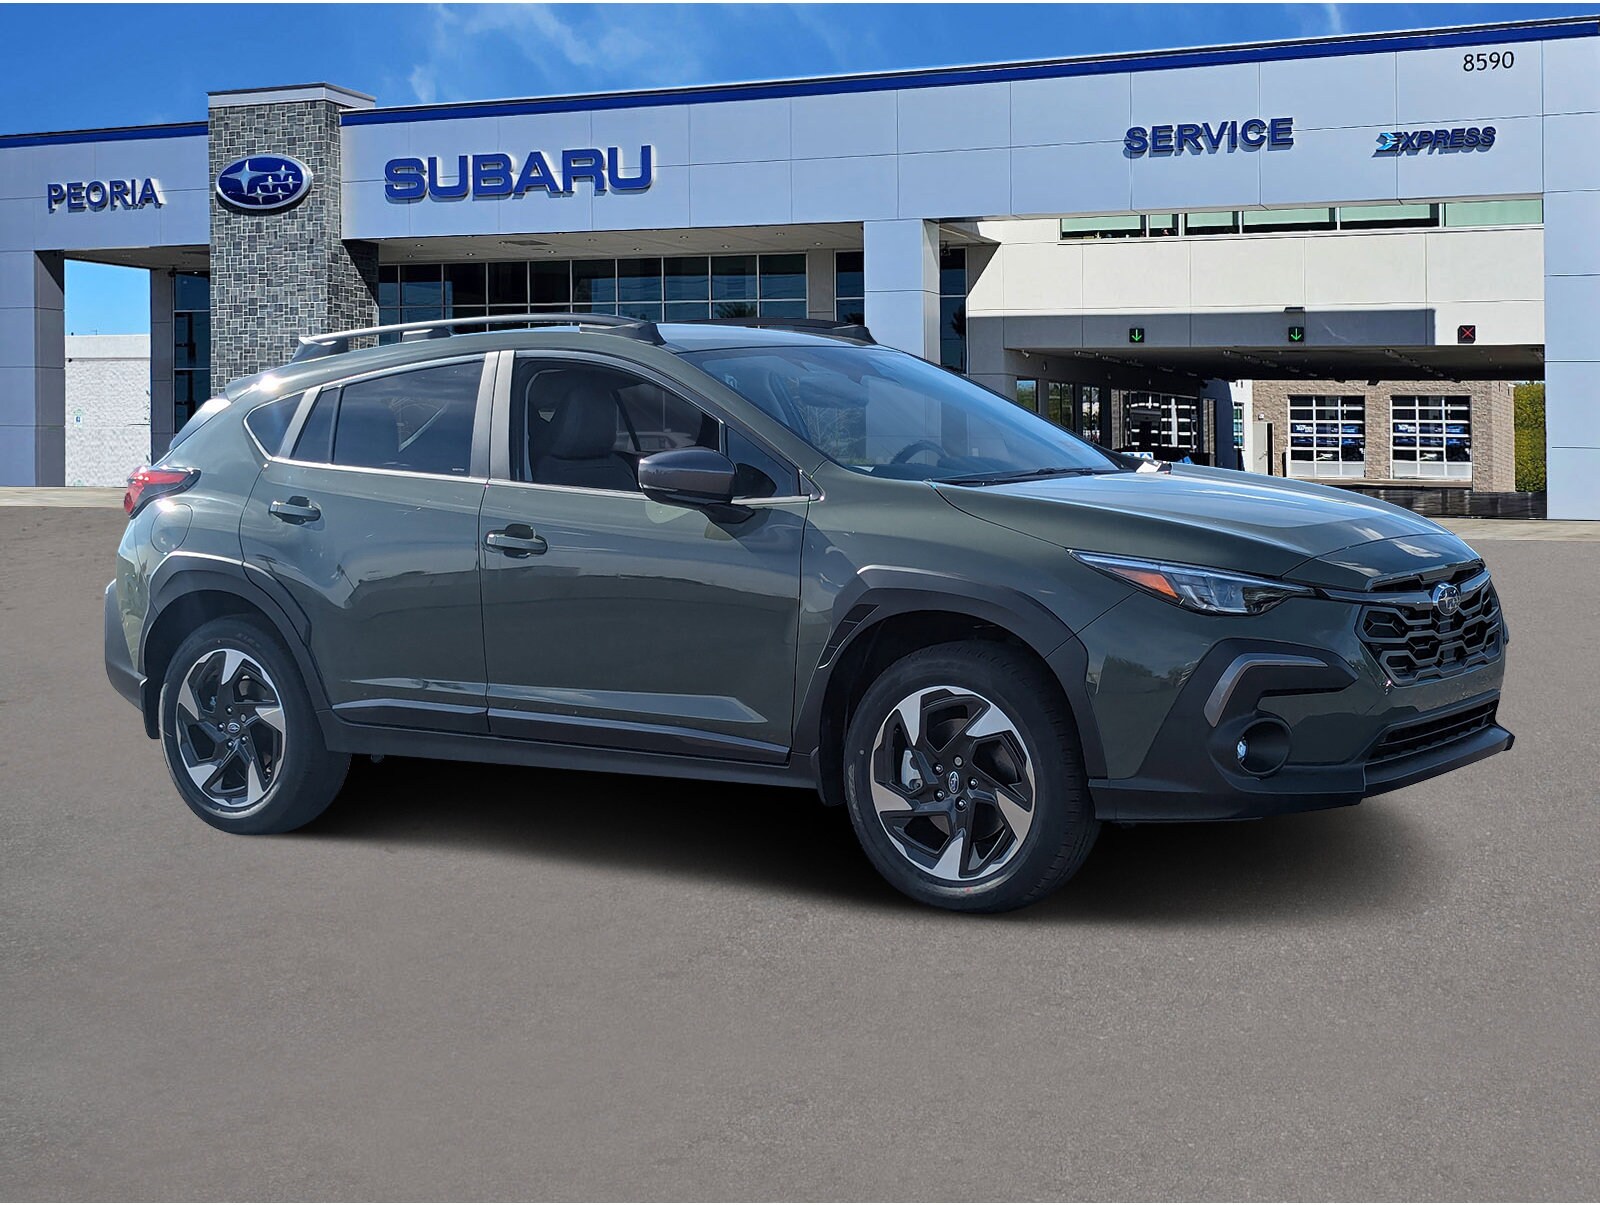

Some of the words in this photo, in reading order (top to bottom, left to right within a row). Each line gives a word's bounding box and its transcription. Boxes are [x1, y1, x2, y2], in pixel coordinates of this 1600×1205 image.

[1463, 51, 1514, 71] 8590
[1126, 117, 1293, 151] SERVICE
[1376, 126, 1496, 150] EXPRESS
[385, 145, 652, 200] SUBARU
[48, 178, 160, 209] PEORIA
